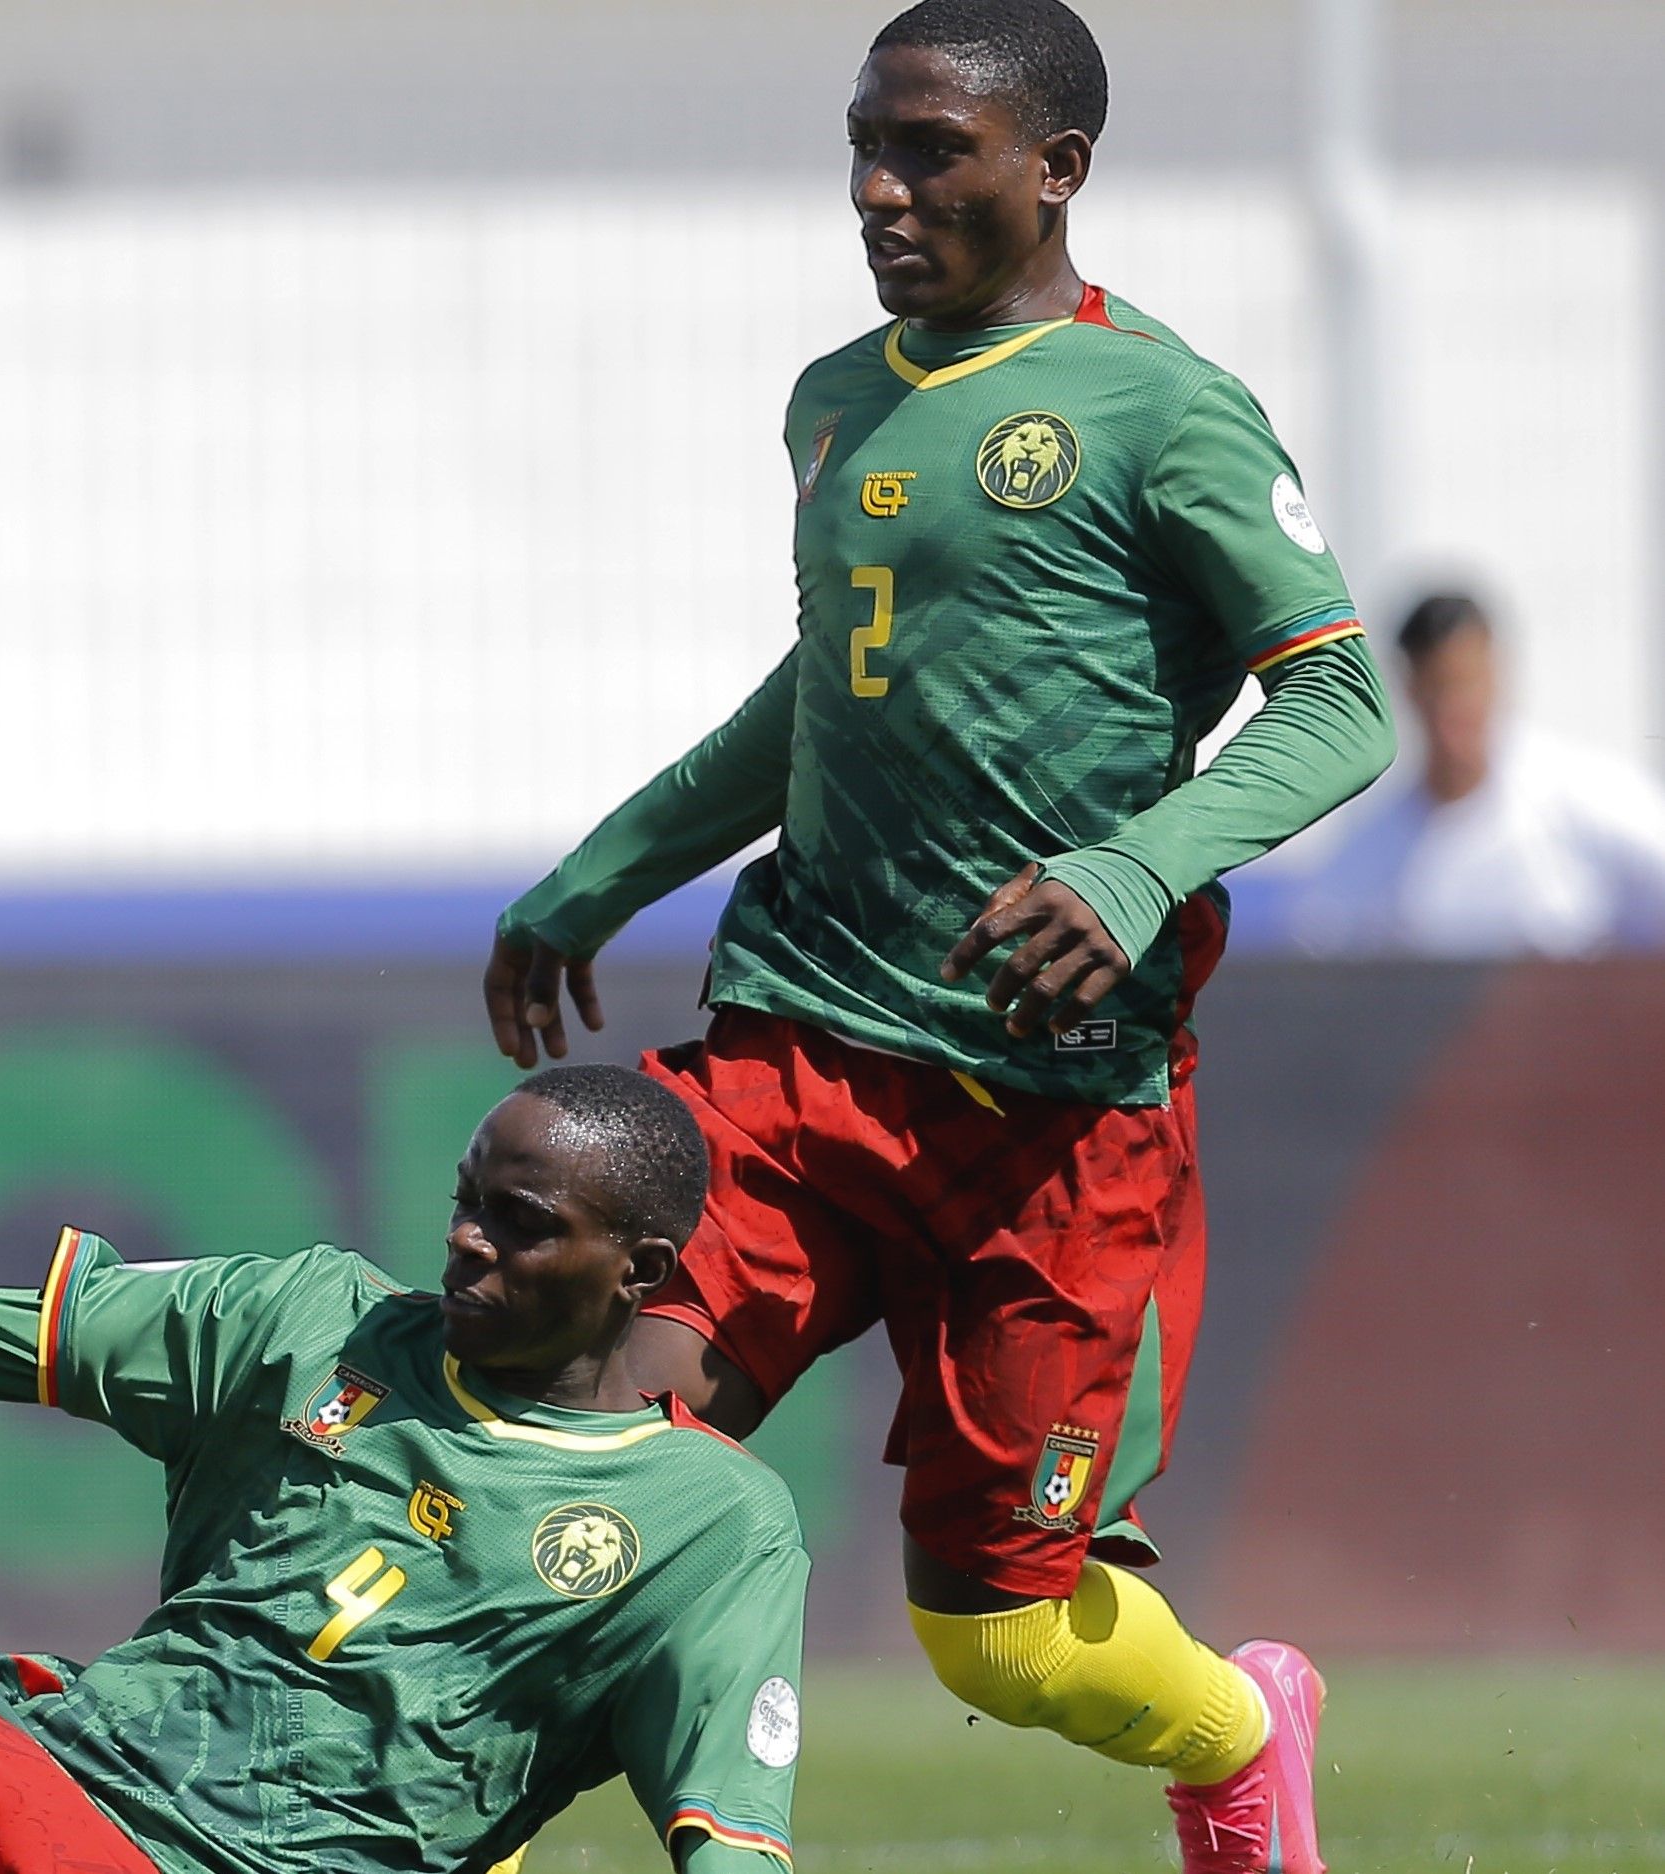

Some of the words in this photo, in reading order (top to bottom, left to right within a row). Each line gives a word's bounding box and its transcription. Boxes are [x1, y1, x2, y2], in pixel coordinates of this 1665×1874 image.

[850, 565, 894, 698] 2
[337, 1366, 386, 1397] CAMEROUN
[306, 1545, 408, 1662] 4
